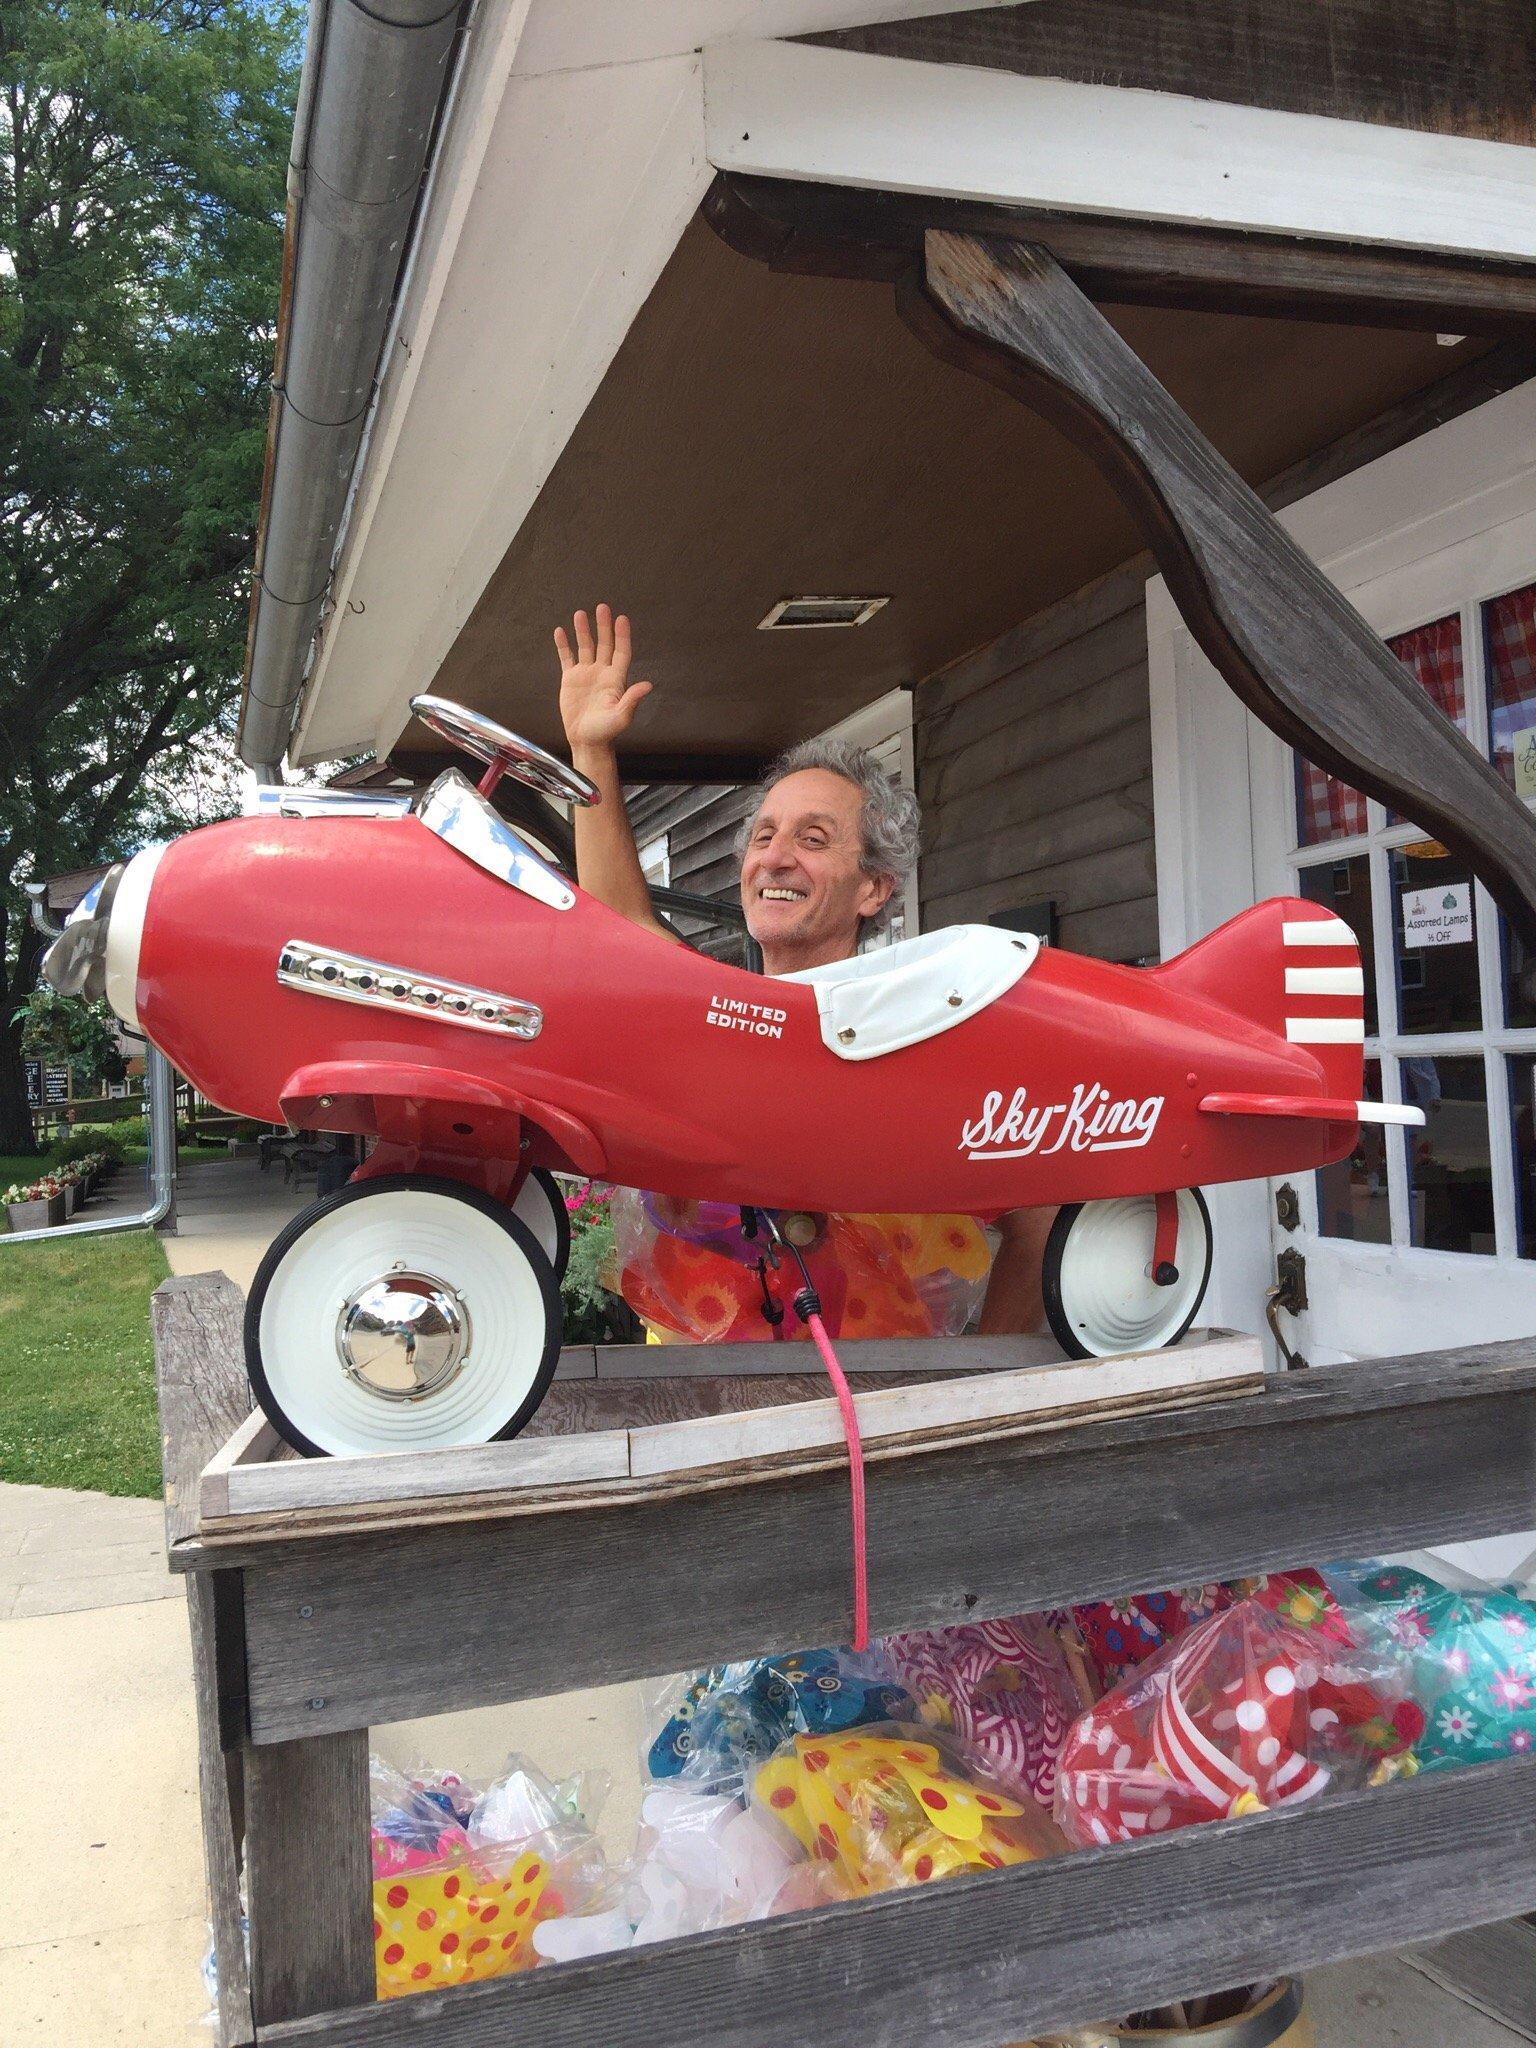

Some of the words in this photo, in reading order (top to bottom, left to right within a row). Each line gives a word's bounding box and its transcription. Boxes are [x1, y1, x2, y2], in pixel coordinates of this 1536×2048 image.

[1407, 917, 1442, 930] Assorted
[1443, 915, 1469, 927] Lamps
[1436, 930, 1451, 942] Off
[711, 995, 787, 1023] LIMITED
[706, 1010, 783, 1040] EDITION
